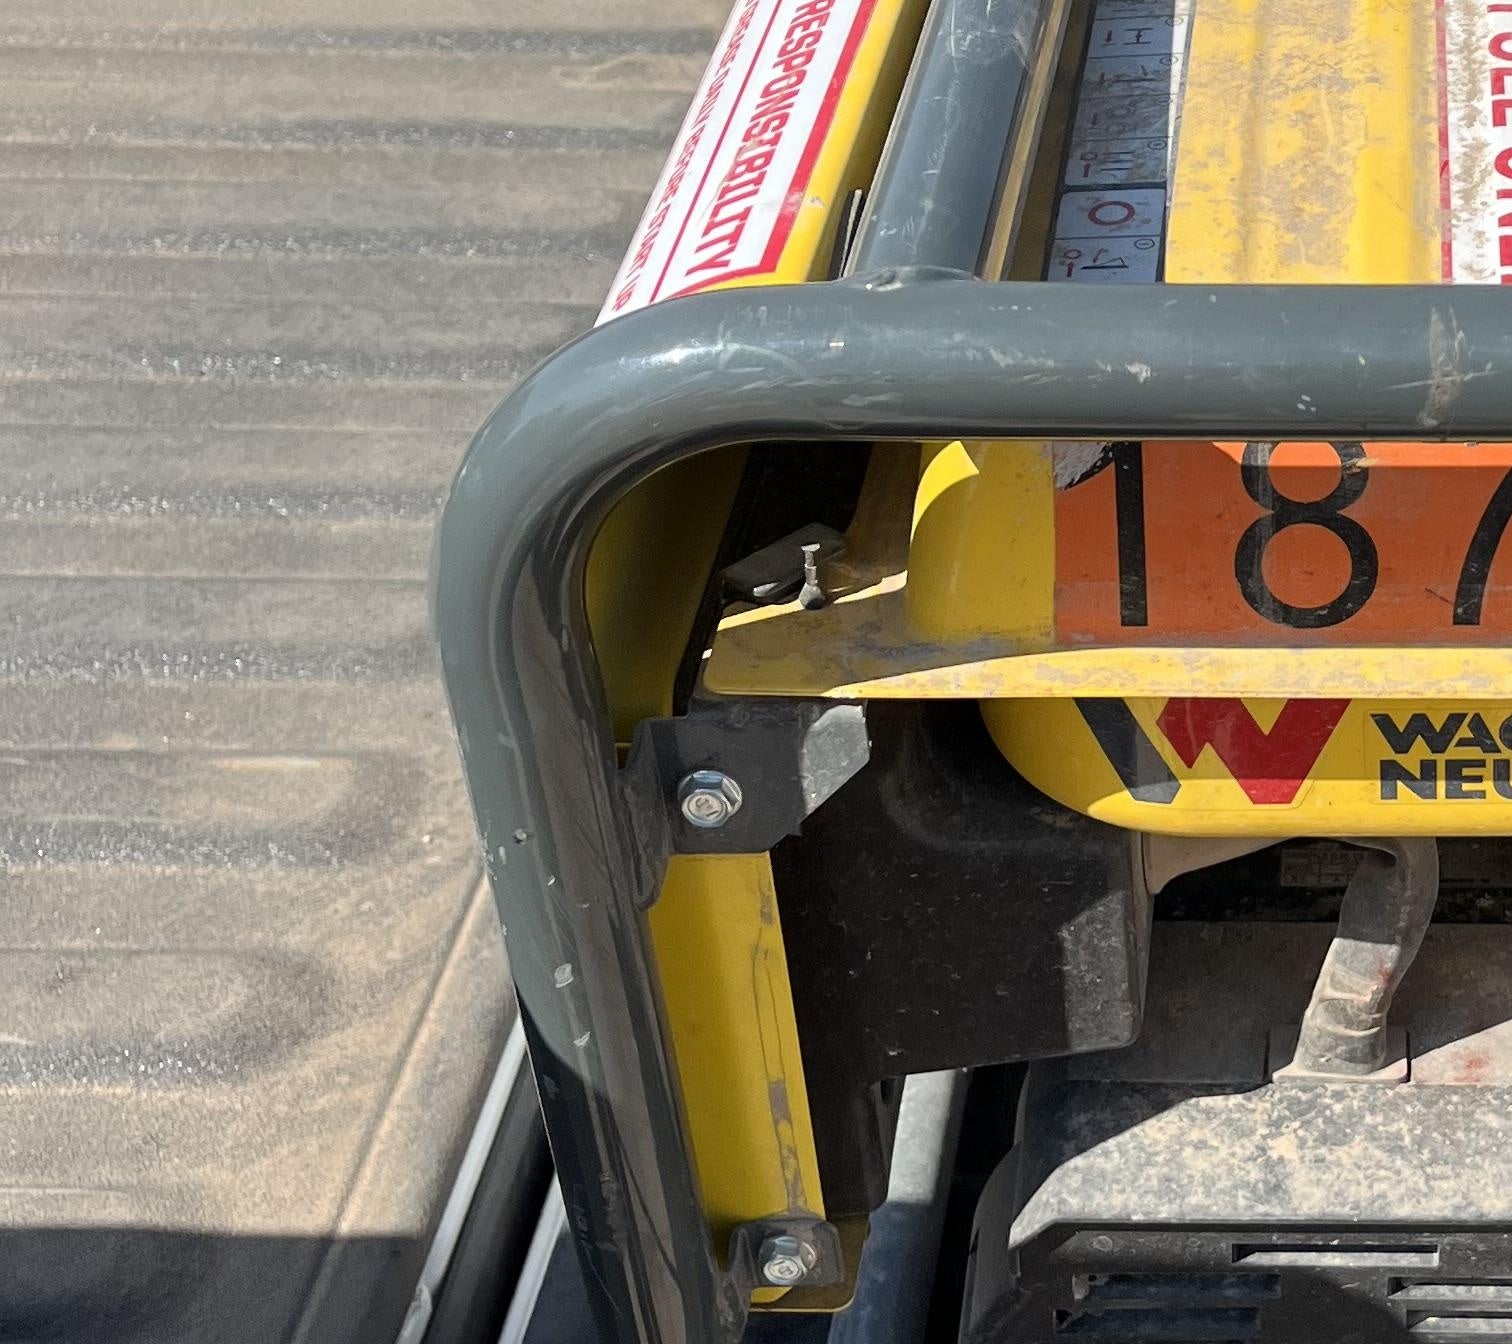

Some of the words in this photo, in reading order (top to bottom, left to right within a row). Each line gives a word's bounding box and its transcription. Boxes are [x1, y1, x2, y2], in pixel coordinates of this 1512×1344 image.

[692, 68, 730, 129] DAILY
[657, 125, 705, 210] BEFORE
[626, 204, 671, 278] START
[613, 274, 640, 311] UP
